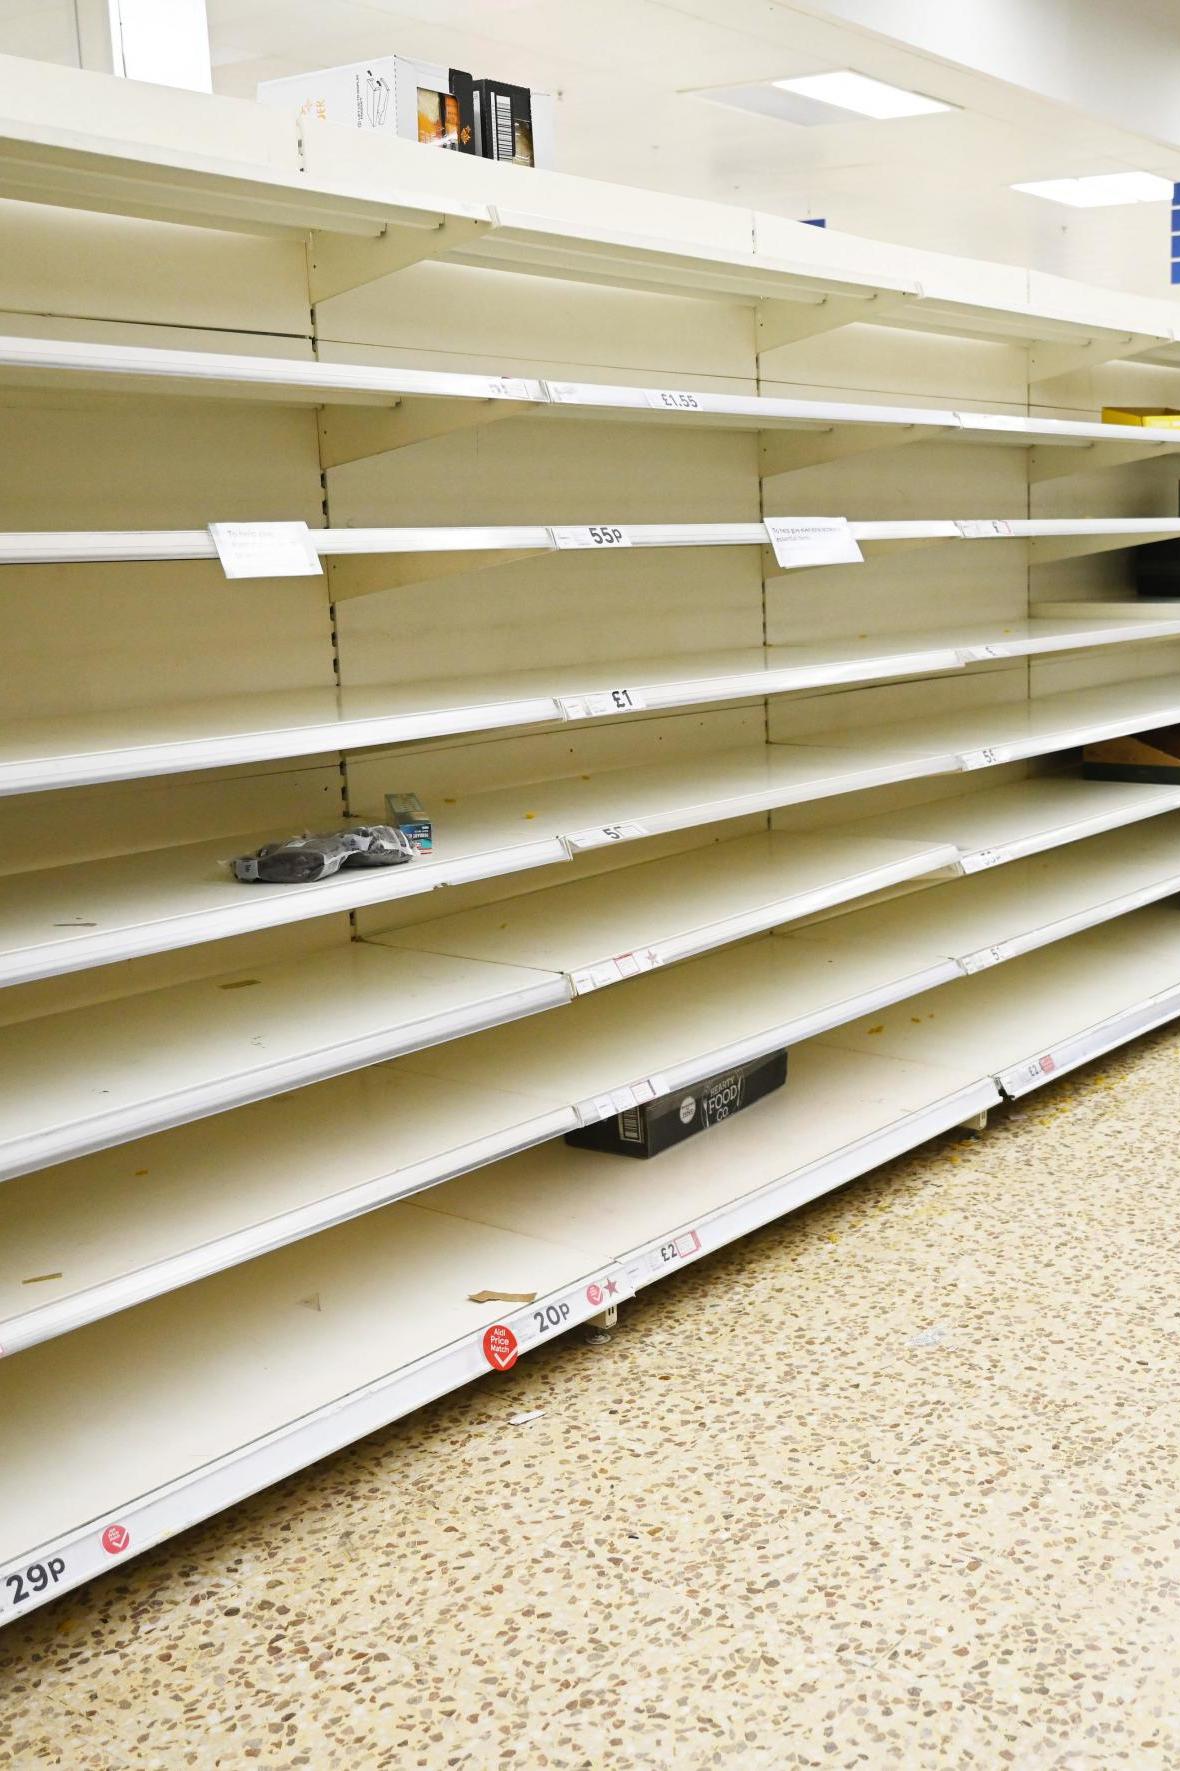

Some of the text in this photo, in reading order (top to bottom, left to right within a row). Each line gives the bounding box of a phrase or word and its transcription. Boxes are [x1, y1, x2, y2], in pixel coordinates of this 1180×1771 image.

[661, 393, 698, 408] £1.55
[589, 527, 623, 545] 55p
[611, 689, 633, 708] £1
[710, 1078, 736, 1097] HEARTY
[708, 1084, 739, 1113] FOOD
[716, 1106, 730, 1122] CO.
[661, 1243, 678, 1262] £2
[534, 1302, 570, 1333] 20p
[490, 1336, 510, 1346] Price
[493, 1328, 506, 1336] Aldi
[490, 1344, 510, 1354] Match
[6, 1557, 66, 1605] 29p
